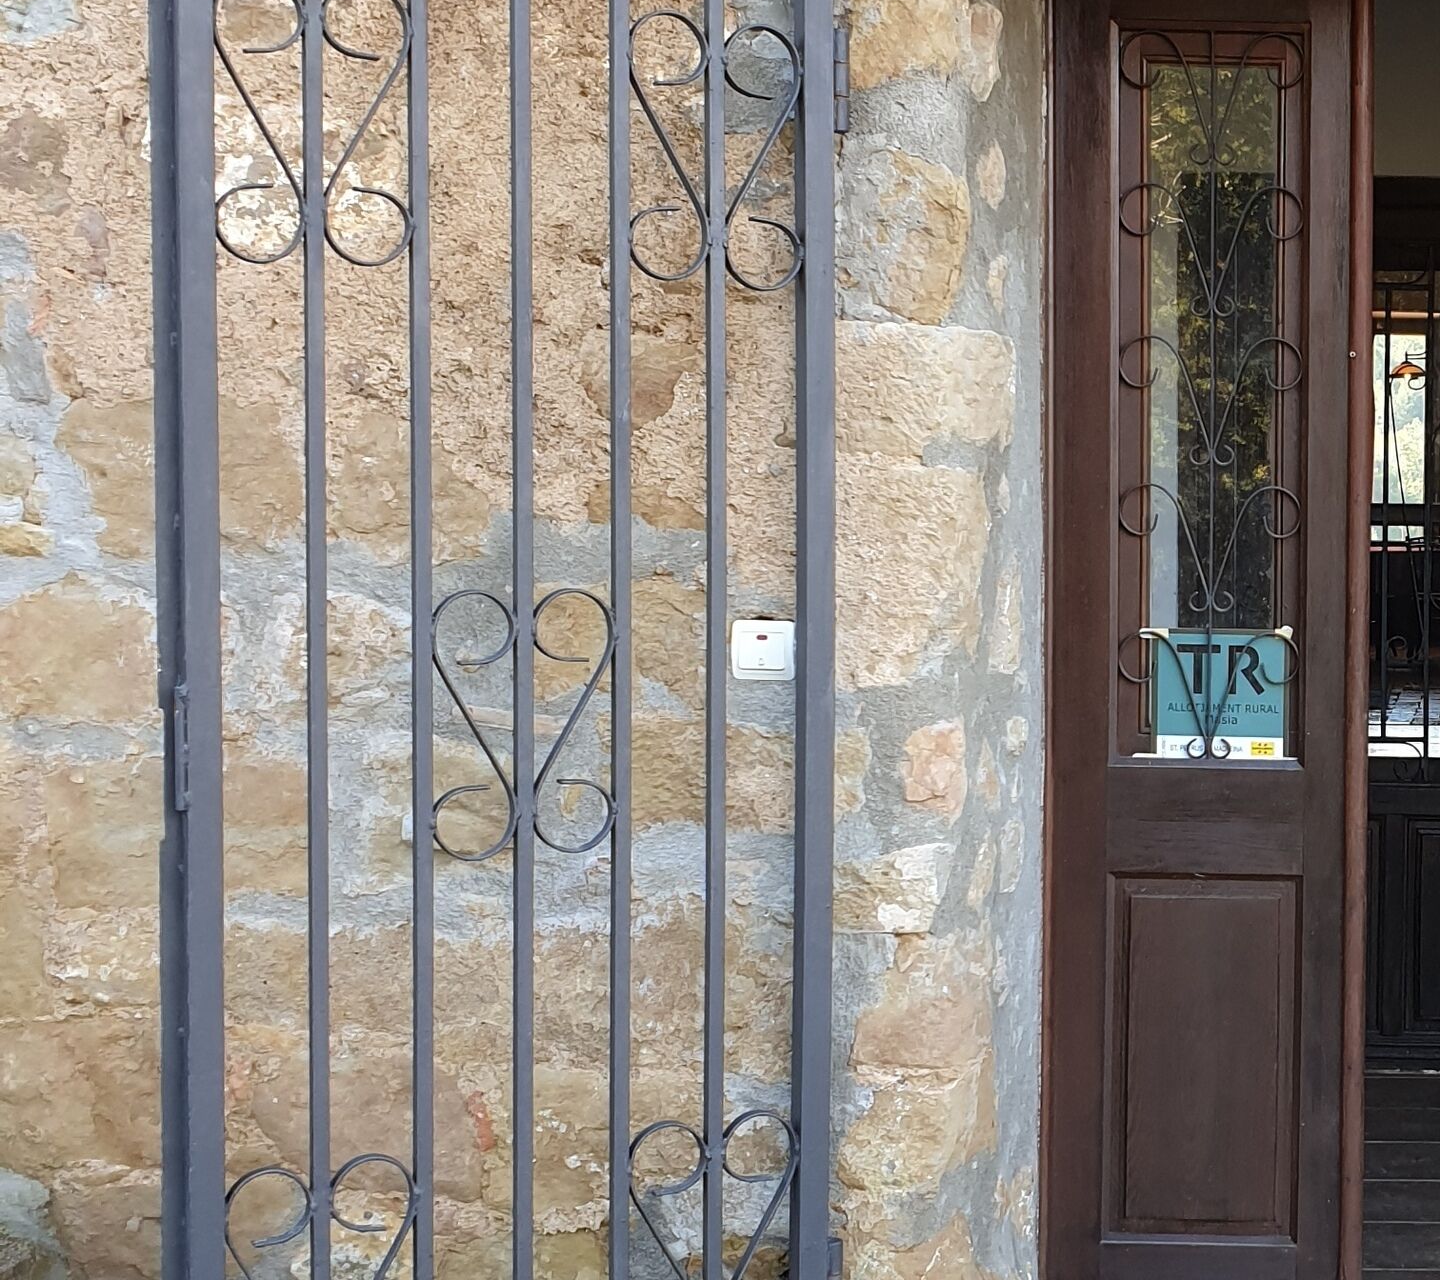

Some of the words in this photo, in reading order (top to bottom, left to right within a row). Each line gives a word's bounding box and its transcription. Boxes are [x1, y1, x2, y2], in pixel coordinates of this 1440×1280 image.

[1176, 643, 1265, 696] TR
[1167, 702, 1242, 713] ALLOTJMENT
[1244, 704, 1280, 714] RURAL
